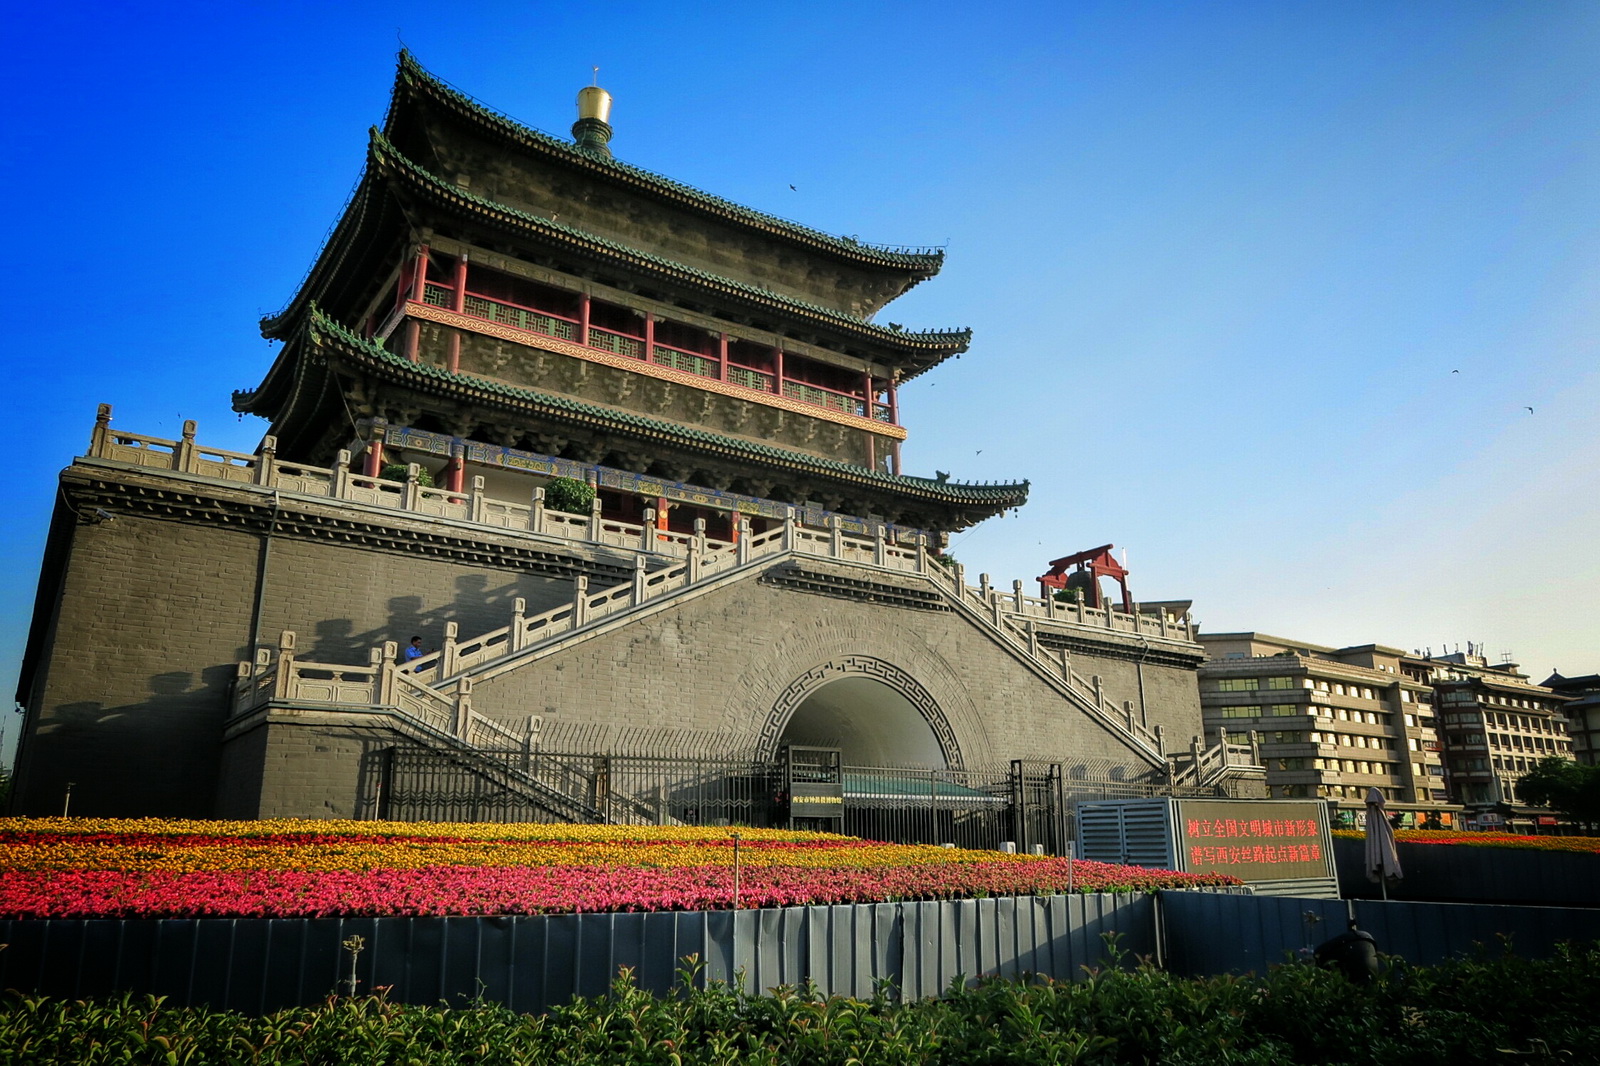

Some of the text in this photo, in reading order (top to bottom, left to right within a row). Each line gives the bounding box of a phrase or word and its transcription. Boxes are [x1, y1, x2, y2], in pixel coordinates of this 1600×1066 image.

[1187, 819, 1318, 838] 树立全国文明城市新形象
[1190, 844, 1321, 866] 谱写西安丝路起点新篇章
